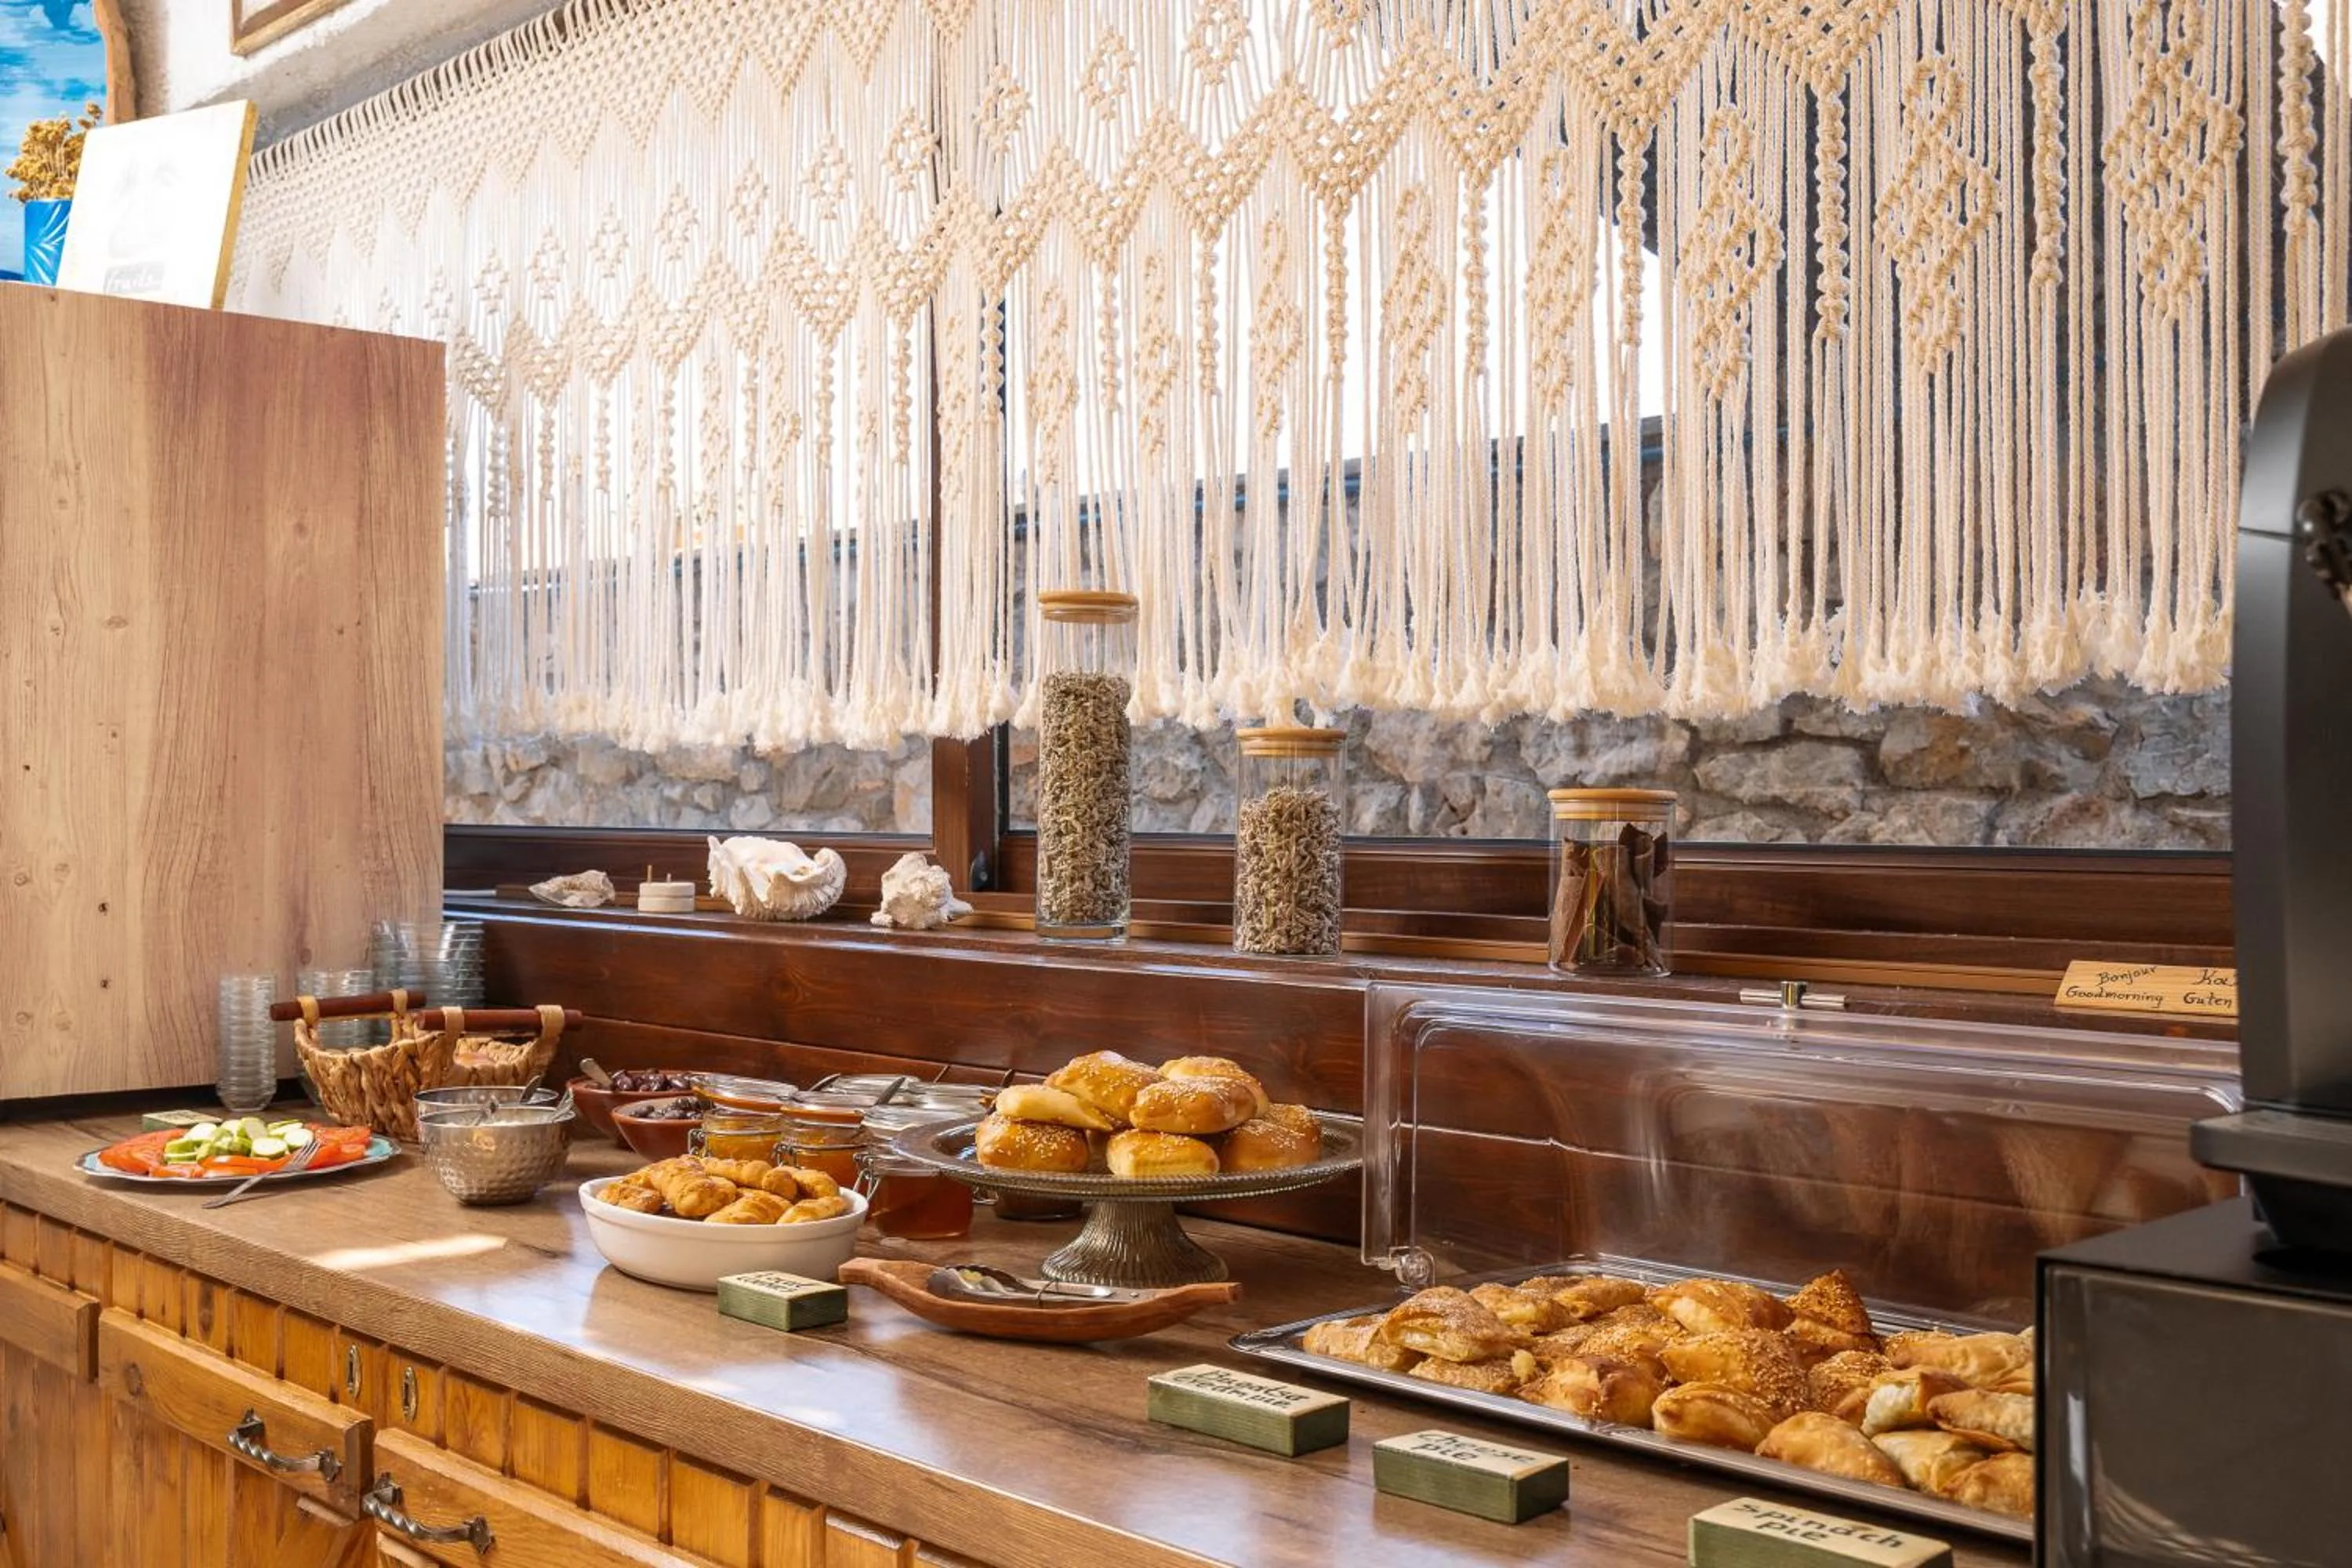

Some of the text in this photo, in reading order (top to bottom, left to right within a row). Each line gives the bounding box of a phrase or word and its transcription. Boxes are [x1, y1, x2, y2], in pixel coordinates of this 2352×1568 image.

[2096, 965, 2158, 987] Bonjour
[2065, 985, 2164, 1009] Goodmorning
[2183, 991, 2233, 1009] Guten
[1413, 1443, 1478, 1461] pie
[1755, 1521, 1830, 1543] pie
